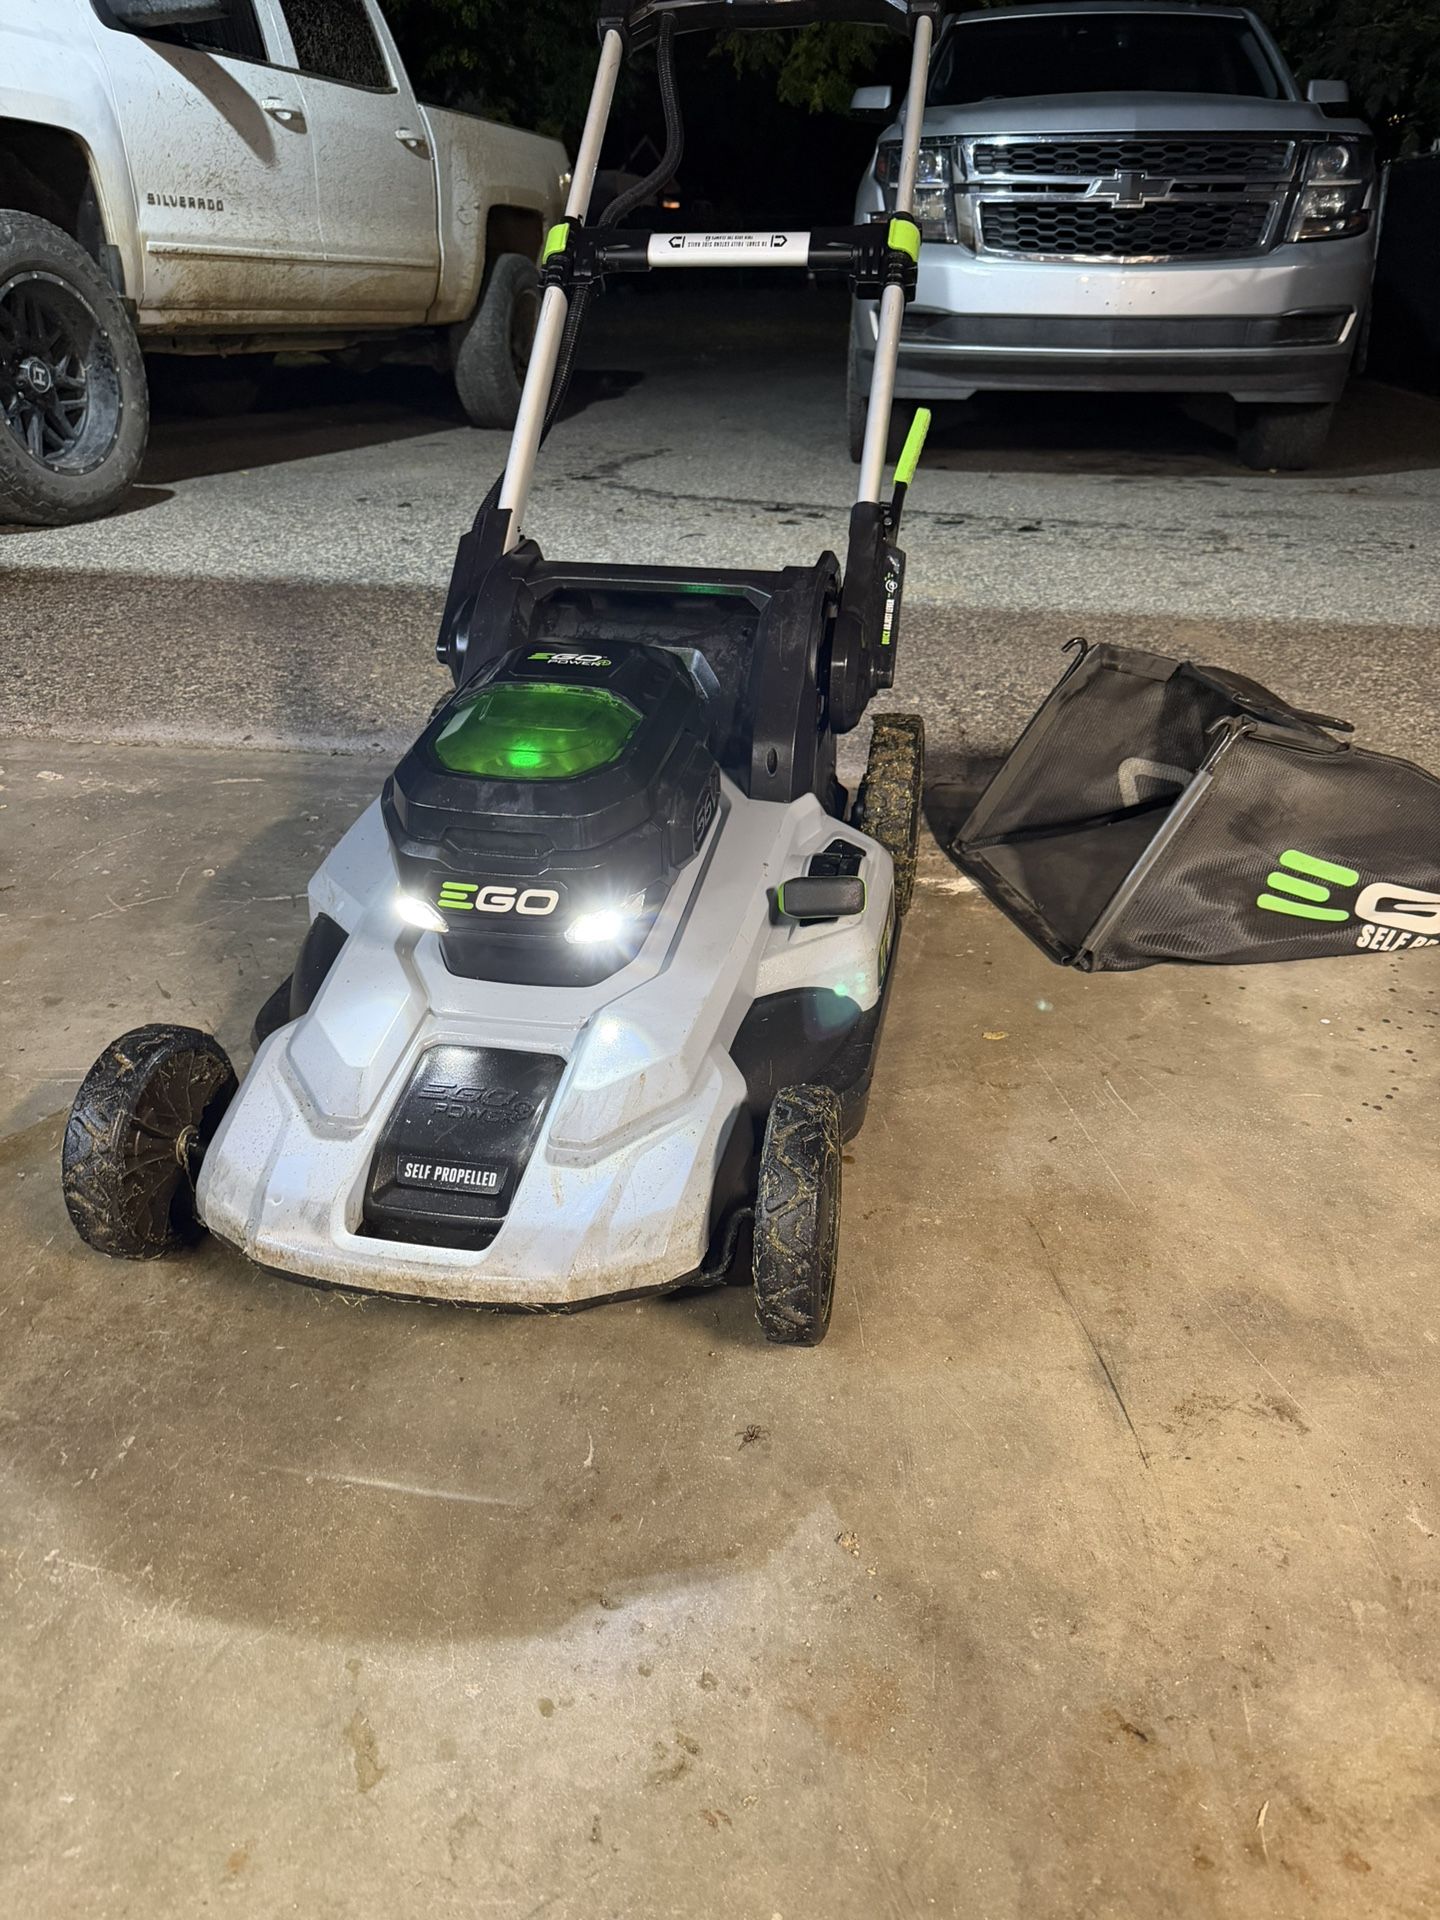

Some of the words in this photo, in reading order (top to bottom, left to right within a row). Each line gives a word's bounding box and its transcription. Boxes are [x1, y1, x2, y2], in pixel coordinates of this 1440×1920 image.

[147, 192, 224, 211] SILVERADO
[527, 652, 602, 661] EGO
[437, 881, 560, 916] EGO
[1355, 924, 1411, 952] SELF
[404, 1162, 432, 1181] SELF
[433, 1165, 498, 1188] PROPELLED
